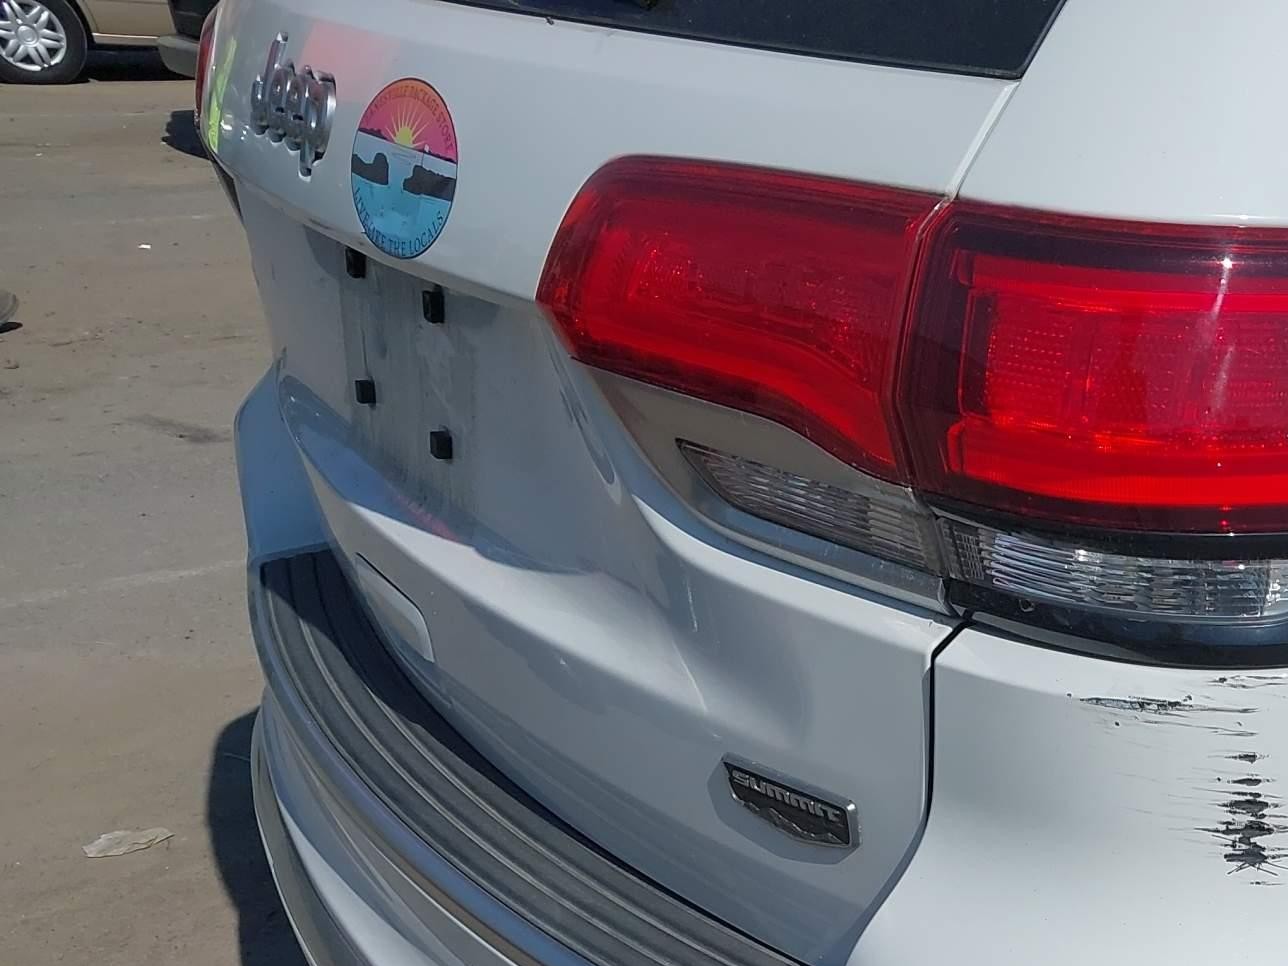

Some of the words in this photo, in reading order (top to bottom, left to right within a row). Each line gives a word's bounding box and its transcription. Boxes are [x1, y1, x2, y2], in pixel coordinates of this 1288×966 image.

[251, 31, 336, 181] Jeep
[388, 237, 406, 257] THE
[409, 210, 444, 255] LOCALS
